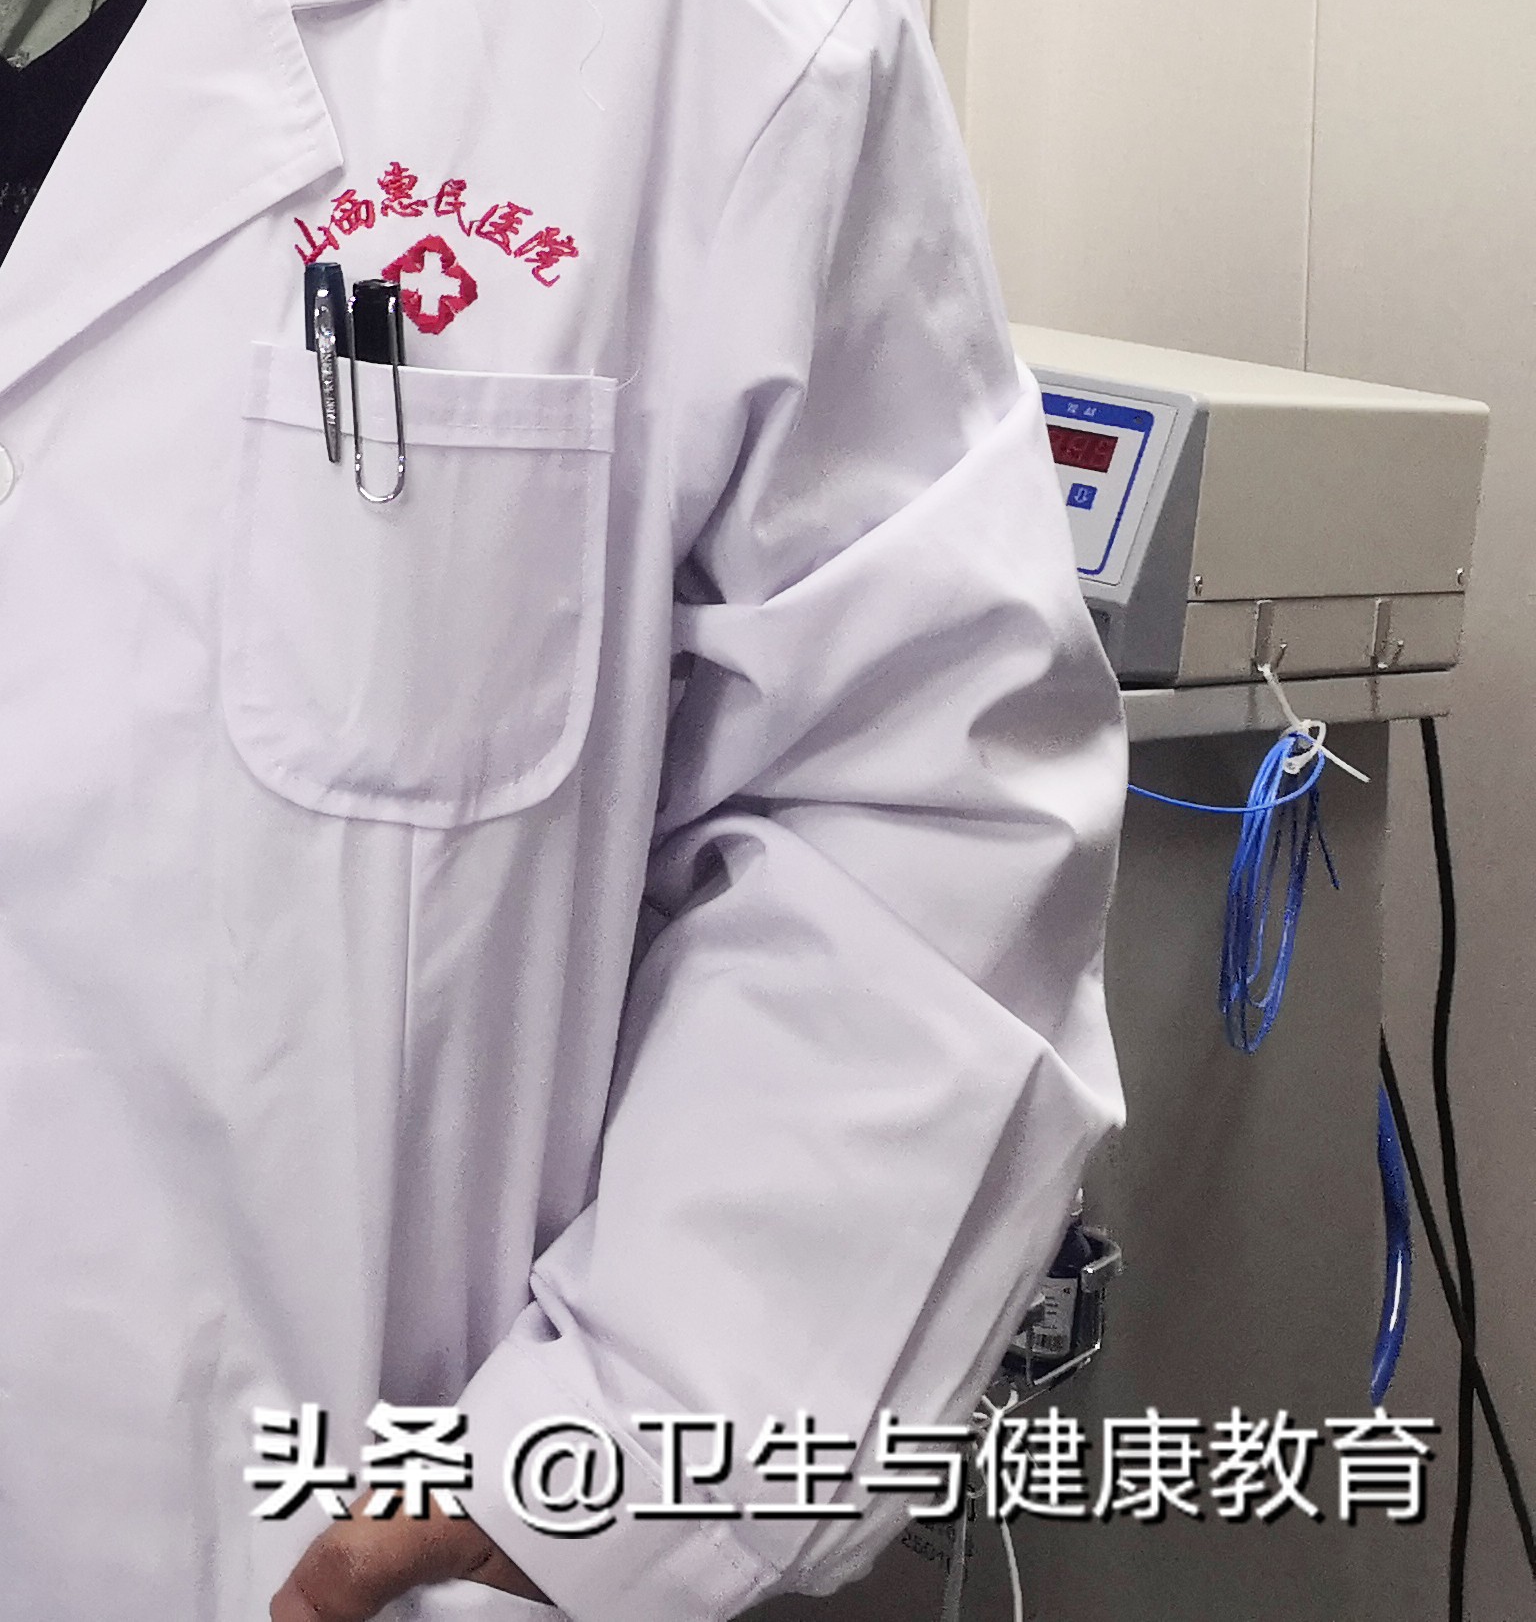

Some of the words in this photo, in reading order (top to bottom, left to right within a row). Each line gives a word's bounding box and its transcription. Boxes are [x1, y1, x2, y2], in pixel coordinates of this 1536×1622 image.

[294, 162, 579, 286] 山西惠民医院
